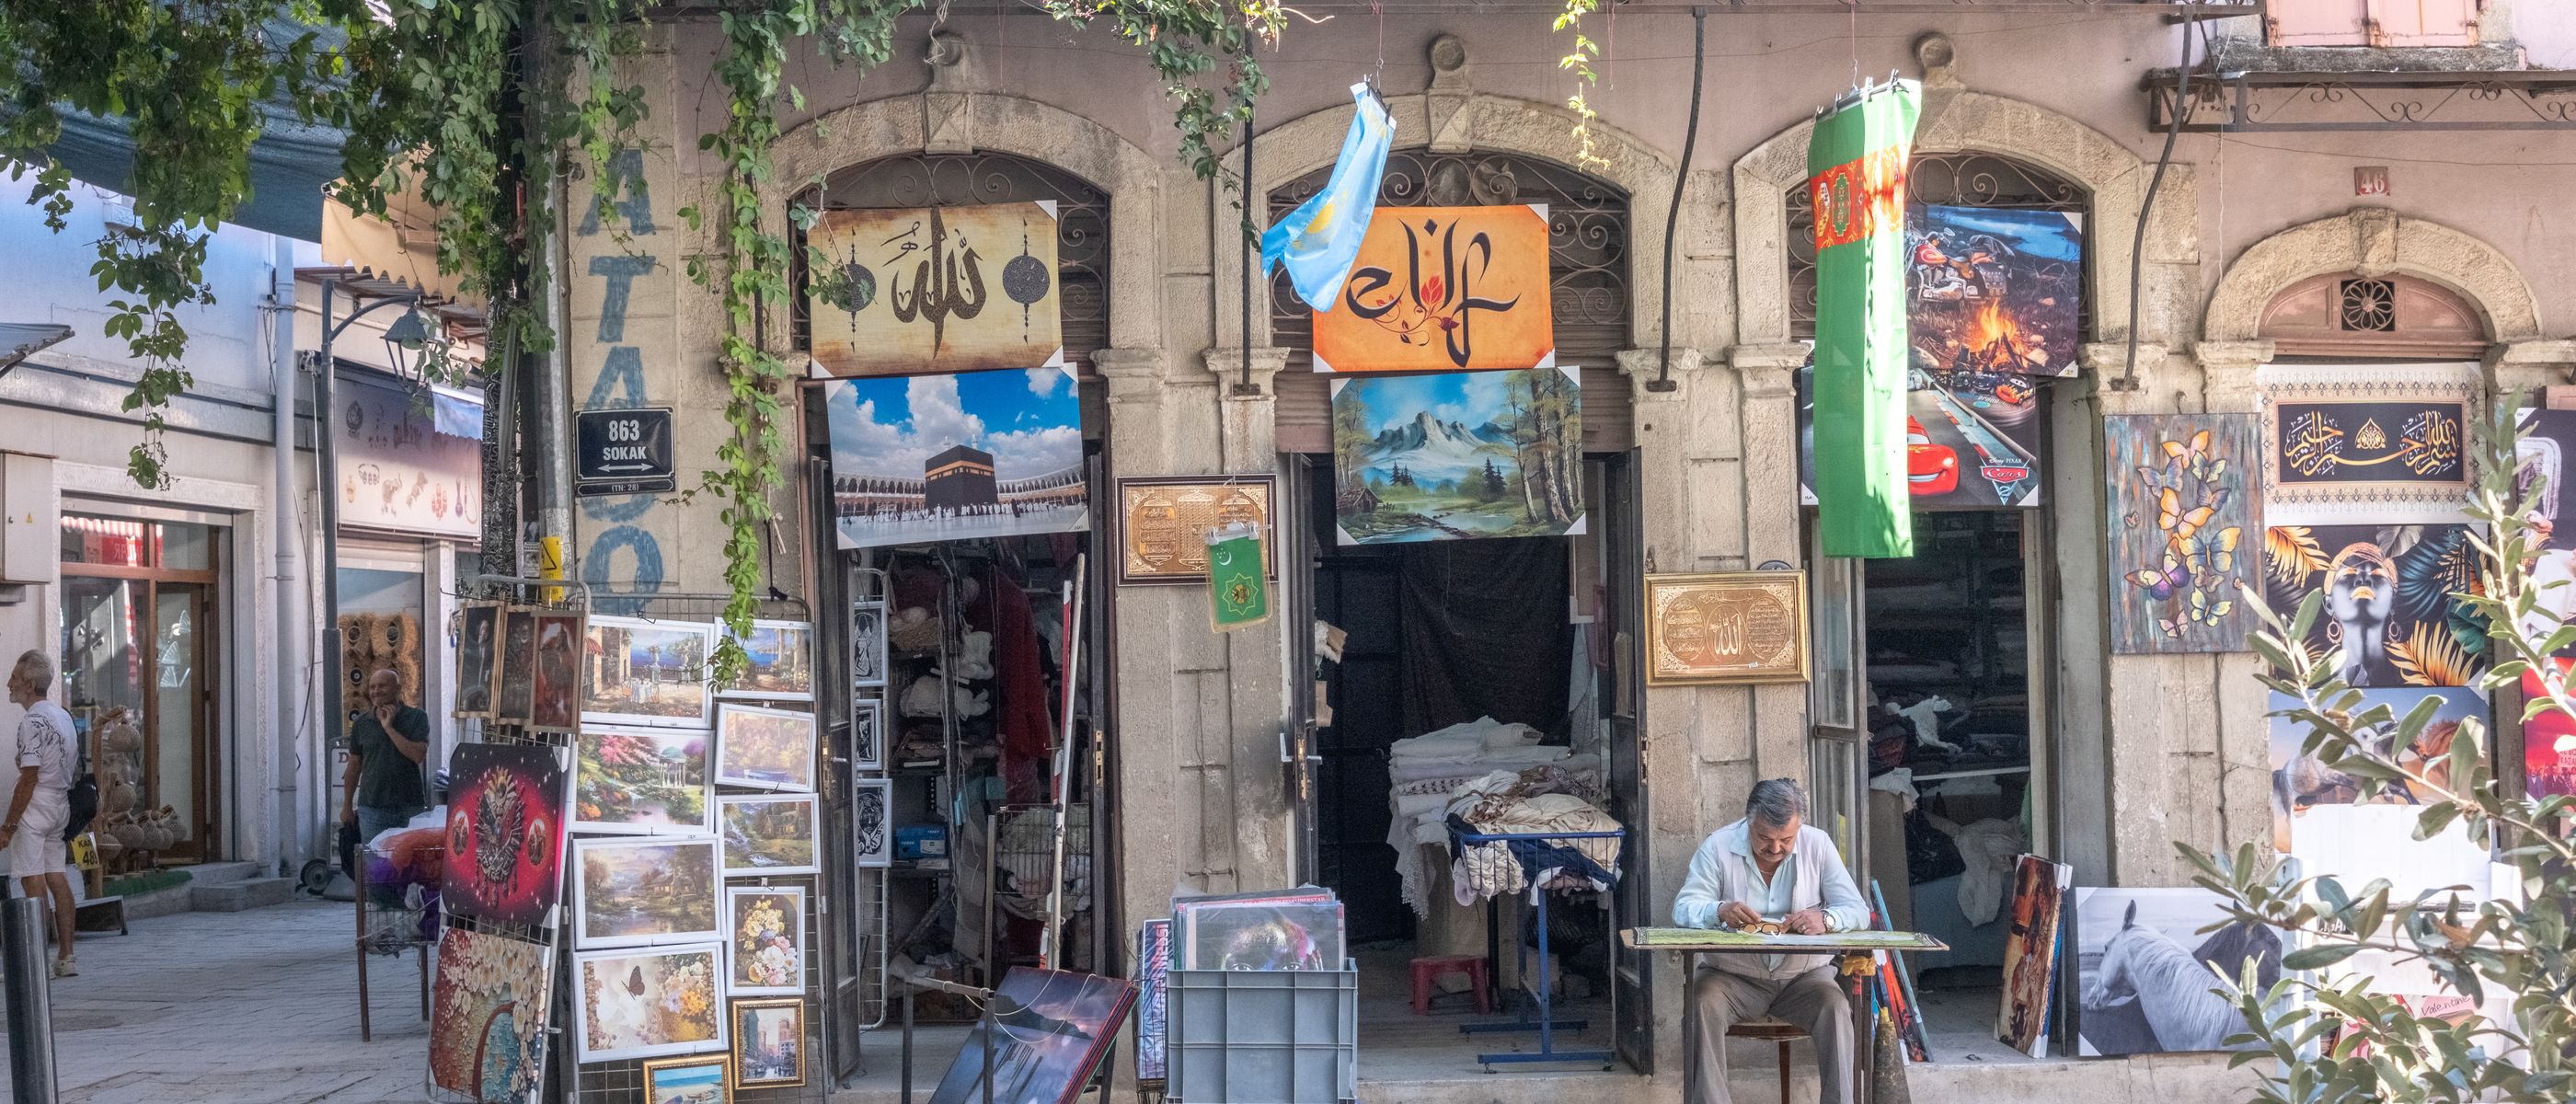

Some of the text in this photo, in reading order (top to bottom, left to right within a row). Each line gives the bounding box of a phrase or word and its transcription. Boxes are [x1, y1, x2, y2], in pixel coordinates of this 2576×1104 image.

[2361, 170, 2386, 193] 46
[1345, 215, 1523, 368] elif
[608, 420, 640, 442] 863
[603, 446, 647, 461] SOKAK
[1989, 456, 2004, 465] Disney
[1986, 468, 2022, 477] Cars
[611, 483, 639, 492] (TN: 28)
[1999, 486, 2010, 497] 2
[2421, 996, 2471, 1017] Valentine
